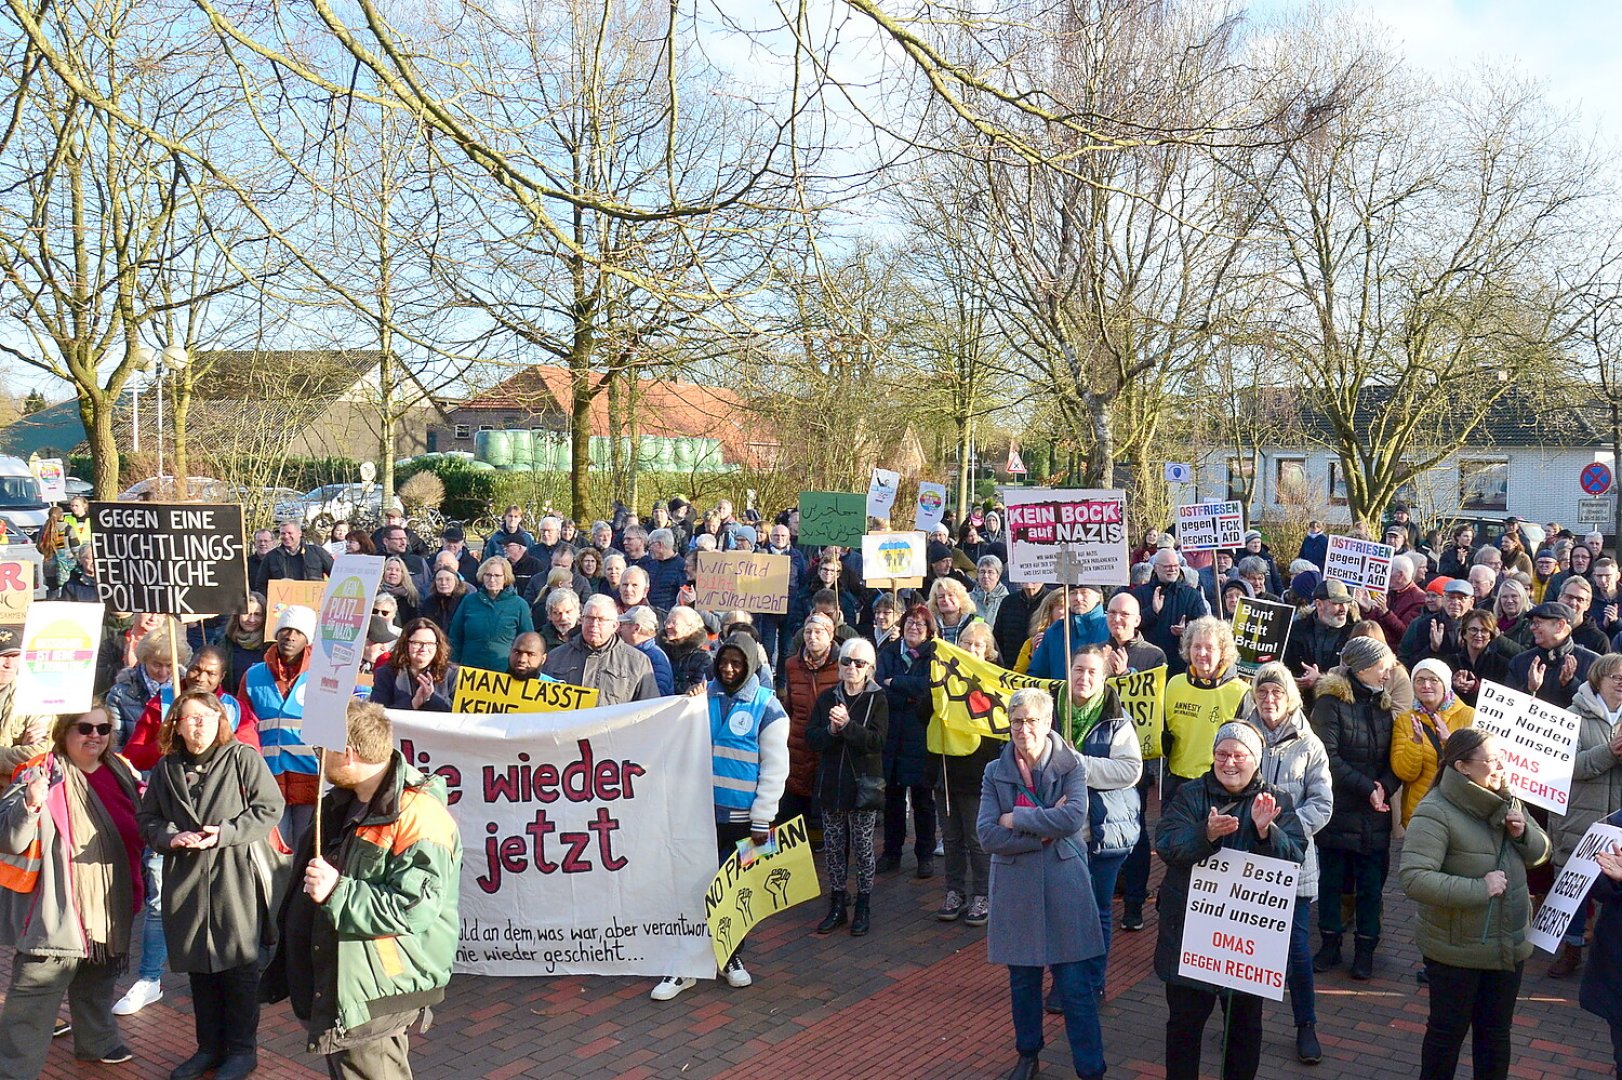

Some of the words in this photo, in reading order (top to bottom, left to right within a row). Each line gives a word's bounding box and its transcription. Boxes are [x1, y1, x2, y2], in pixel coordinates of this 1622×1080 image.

[99, 509, 158, 528] GEGEN
[170, 510, 216, 530] EINE
[1009, 506, 1055, 524] KEIN
[1062, 504, 1118, 522] BOCK
[1180, 503, 1239, 517] OSTFRIESEN
[1028, 526, 1053, 538] auf
[1056, 523, 1121, 542] NAZIS
[1182, 520, 1211, 531] gegen
[1220, 520, 1240, 531] FCK
[1223, 532, 1240, 542] AfD
[92, 532, 243, 560] FLÜCHTLINGS-
[1332, 537, 1392, 558] OSTFRIESEN
[94, 558, 218, 586] FEINDLICHE
[1330, 552, 1360, 565] gegen
[1369, 562, 1388, 575] FCK
[1367, 574, 1386, 586] AfD
[97, 584, 194, 614] POLITIK
[749, 594, 788, 611] mehr
[1241, 604, 1274, 621] Bunt
[1238, 621, 1268, 636] statt
[1235, 635, 1278, 653] Braun!
[460, 668, 511, 696] MAN
[521, 680, 591, 710] LÄSST
[999, 672, 1041, 690] KEIN
[1174, 702, 1202, 712] AMNESTY
[1484, 687, 1515, 707] Das
[1528, 704, 1576, 731] Beste
[1480, 705, 1504, 720] am
[1516, 716, 1571, 747] Norden
[1476, 721, 1512, 738] sind
[1515, 734, 1570, 762] unsere
[482, 739, 647, 803] wieder
[1510, 772, 1567, 804] RECHTS
[477, 807, 629, 894] jetzt
[1242, 862, 1294, 887] Beste
[1554, 870, 1591, 900] GEGEN
[705, 877, 724, 918] NO
[1193, 878, 1218, 894] am
[1229, 882, 1288, 910] Norden
[1190, 898, 1226, 918] sind
[1229, 908, 1286, 932] unsere
[1531, 905, 1571, 938] RECHTS
[483, 928, 499, 942] an
[537, 928, 564, 942] was
[605, 916, 639, 939] aber
[456, 946, 478, 962] nie
[484, 944, 537, 961] wieder
[1212, 932, 1255, 956] OMAS
[1183, 951, 1221, 972] GEGEN
[1225, 959, 1283, 988] RECHTS
